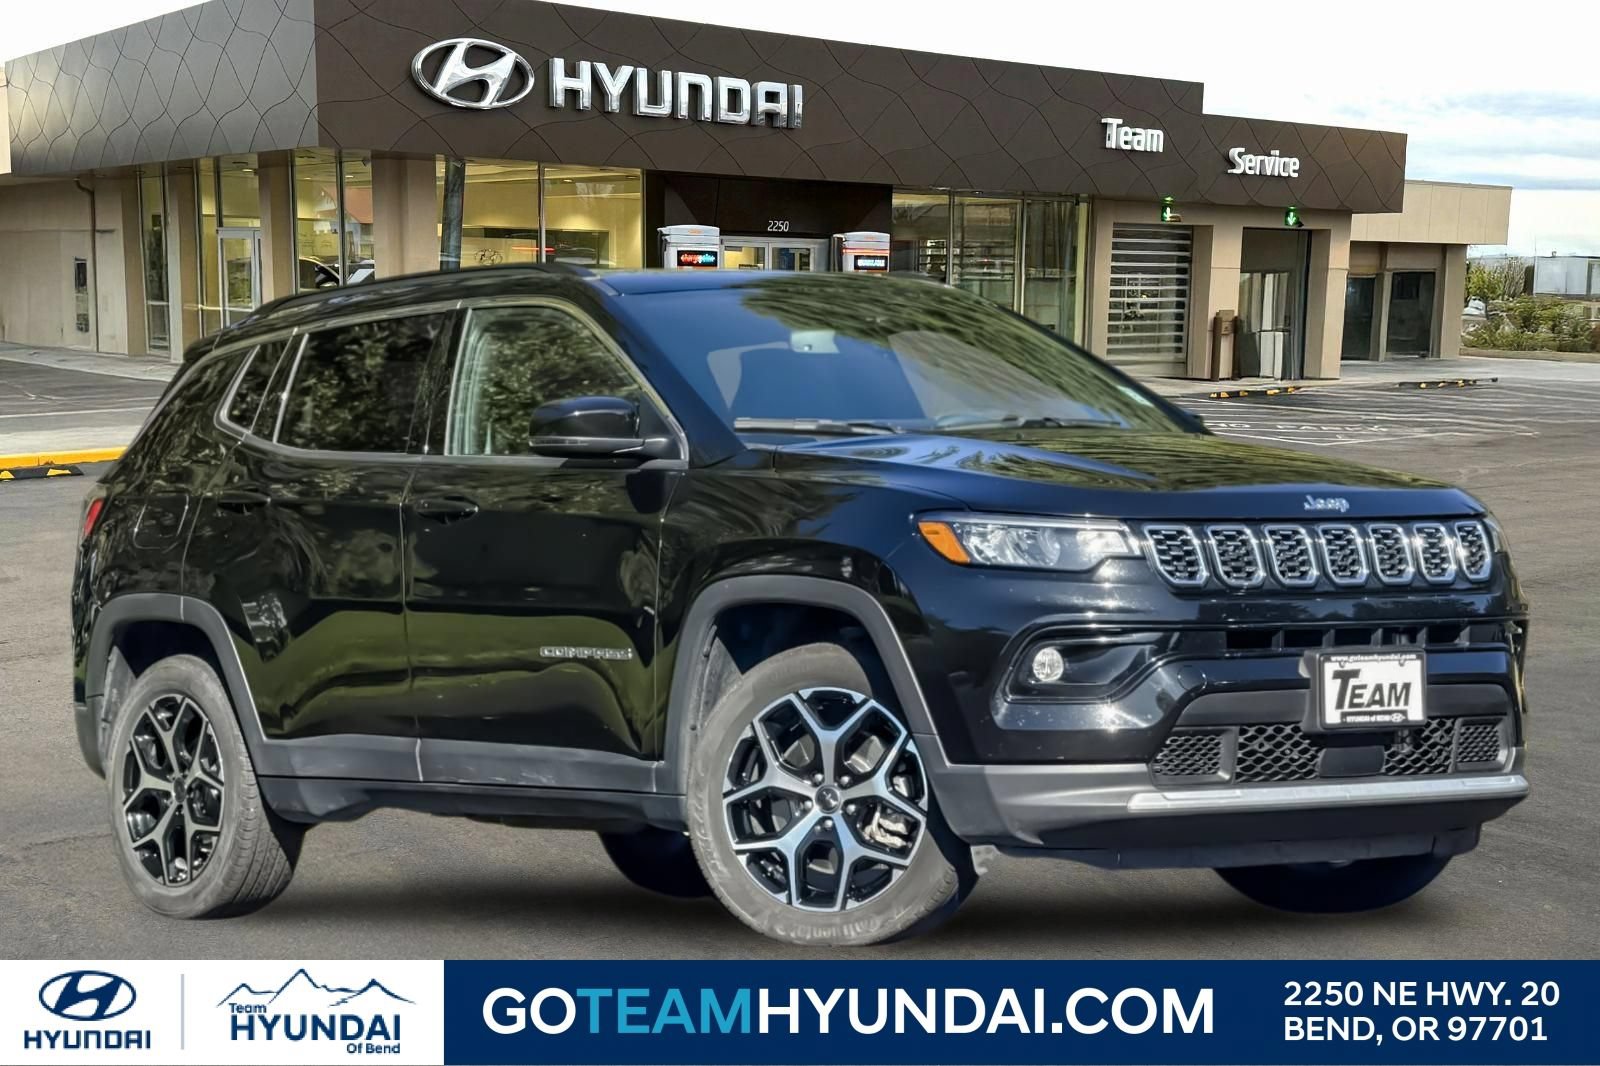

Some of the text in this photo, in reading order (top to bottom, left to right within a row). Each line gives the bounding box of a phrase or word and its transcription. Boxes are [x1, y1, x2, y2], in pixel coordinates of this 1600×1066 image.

[549, 56, 804, 129] HYUNDAI
[1101, 117, 1164, 153] Team
[1227, 147, 1300, 178] Service
[767, 220, 790, 232] 2250
[1303, 494, 1350, 513] Jeep
